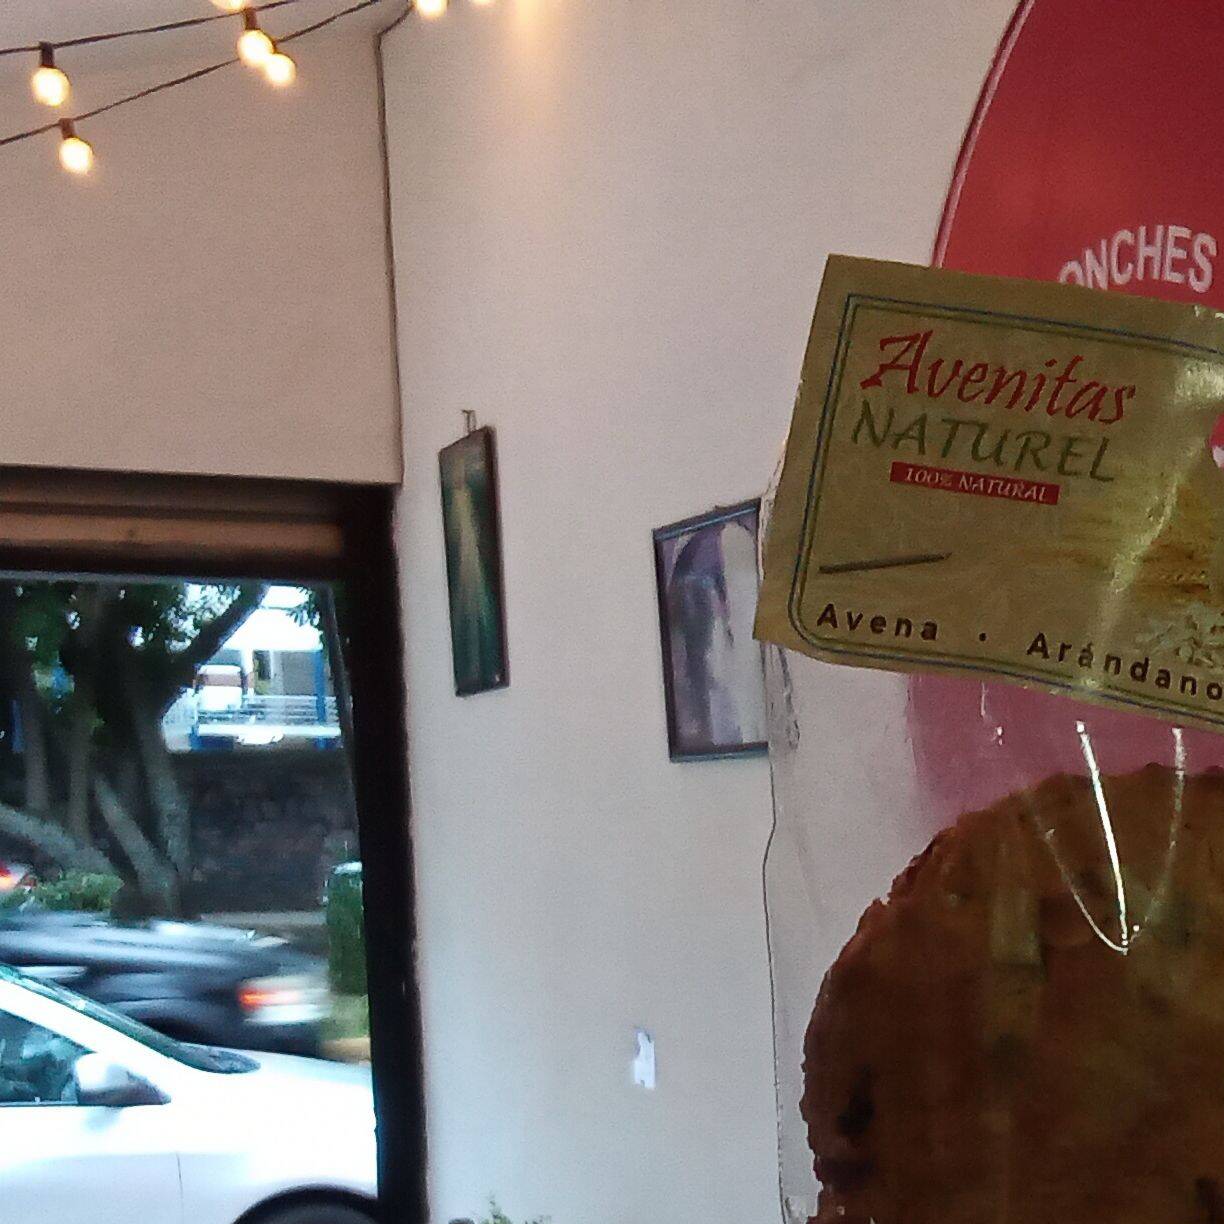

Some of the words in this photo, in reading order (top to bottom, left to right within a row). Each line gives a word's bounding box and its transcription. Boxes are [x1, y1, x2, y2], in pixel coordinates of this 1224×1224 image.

[860, 330, 1136, 425] Avenitas
[850, 399, 1116, 482] NATUREL
[958, 475, 1047, 502] NATURAL
[816, 603, 938, 642] Avena
[1026, 632, 1224, 701] Arándano
